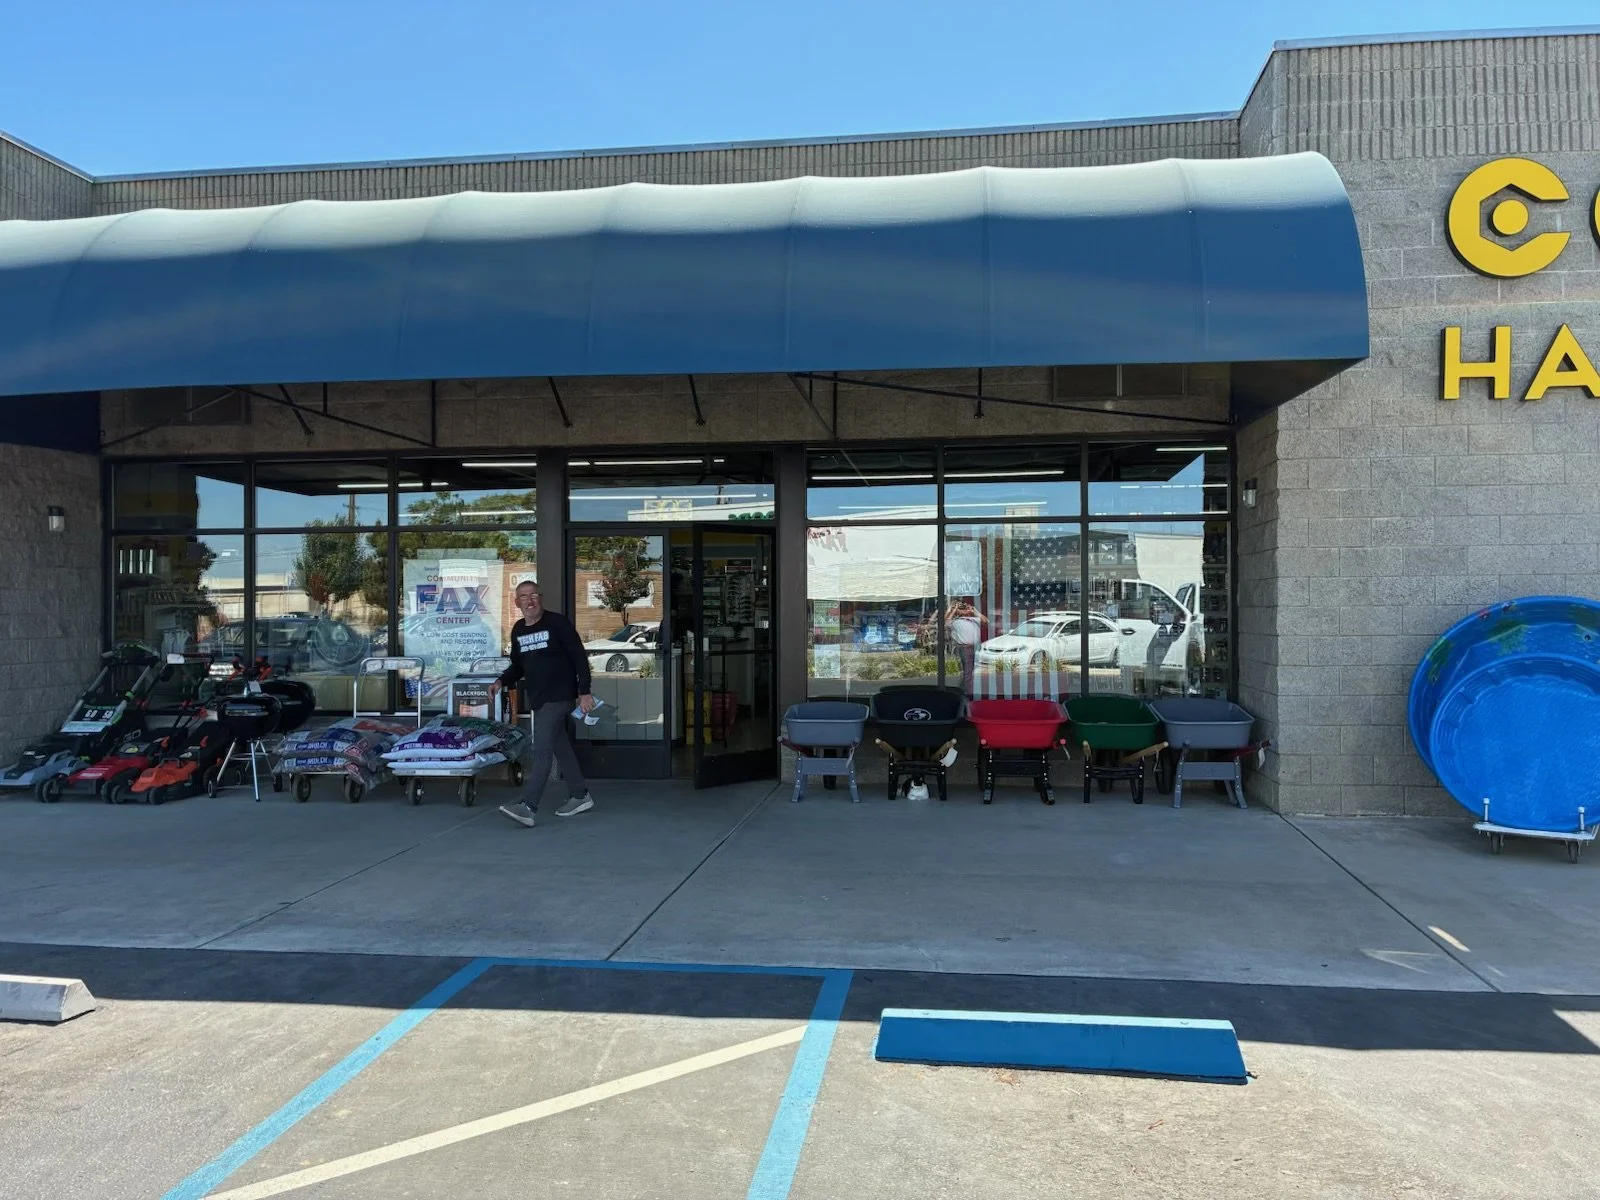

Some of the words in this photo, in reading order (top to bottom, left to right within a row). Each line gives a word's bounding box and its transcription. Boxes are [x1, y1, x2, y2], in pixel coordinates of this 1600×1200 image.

[1446, 156, 1600, 279] C
[1442, 322, 1600, 401] HA
[416, 585, 490, 614] FAX
[517, 633, 535, 646] TECH
[534, 631, 549, 642] FAB
